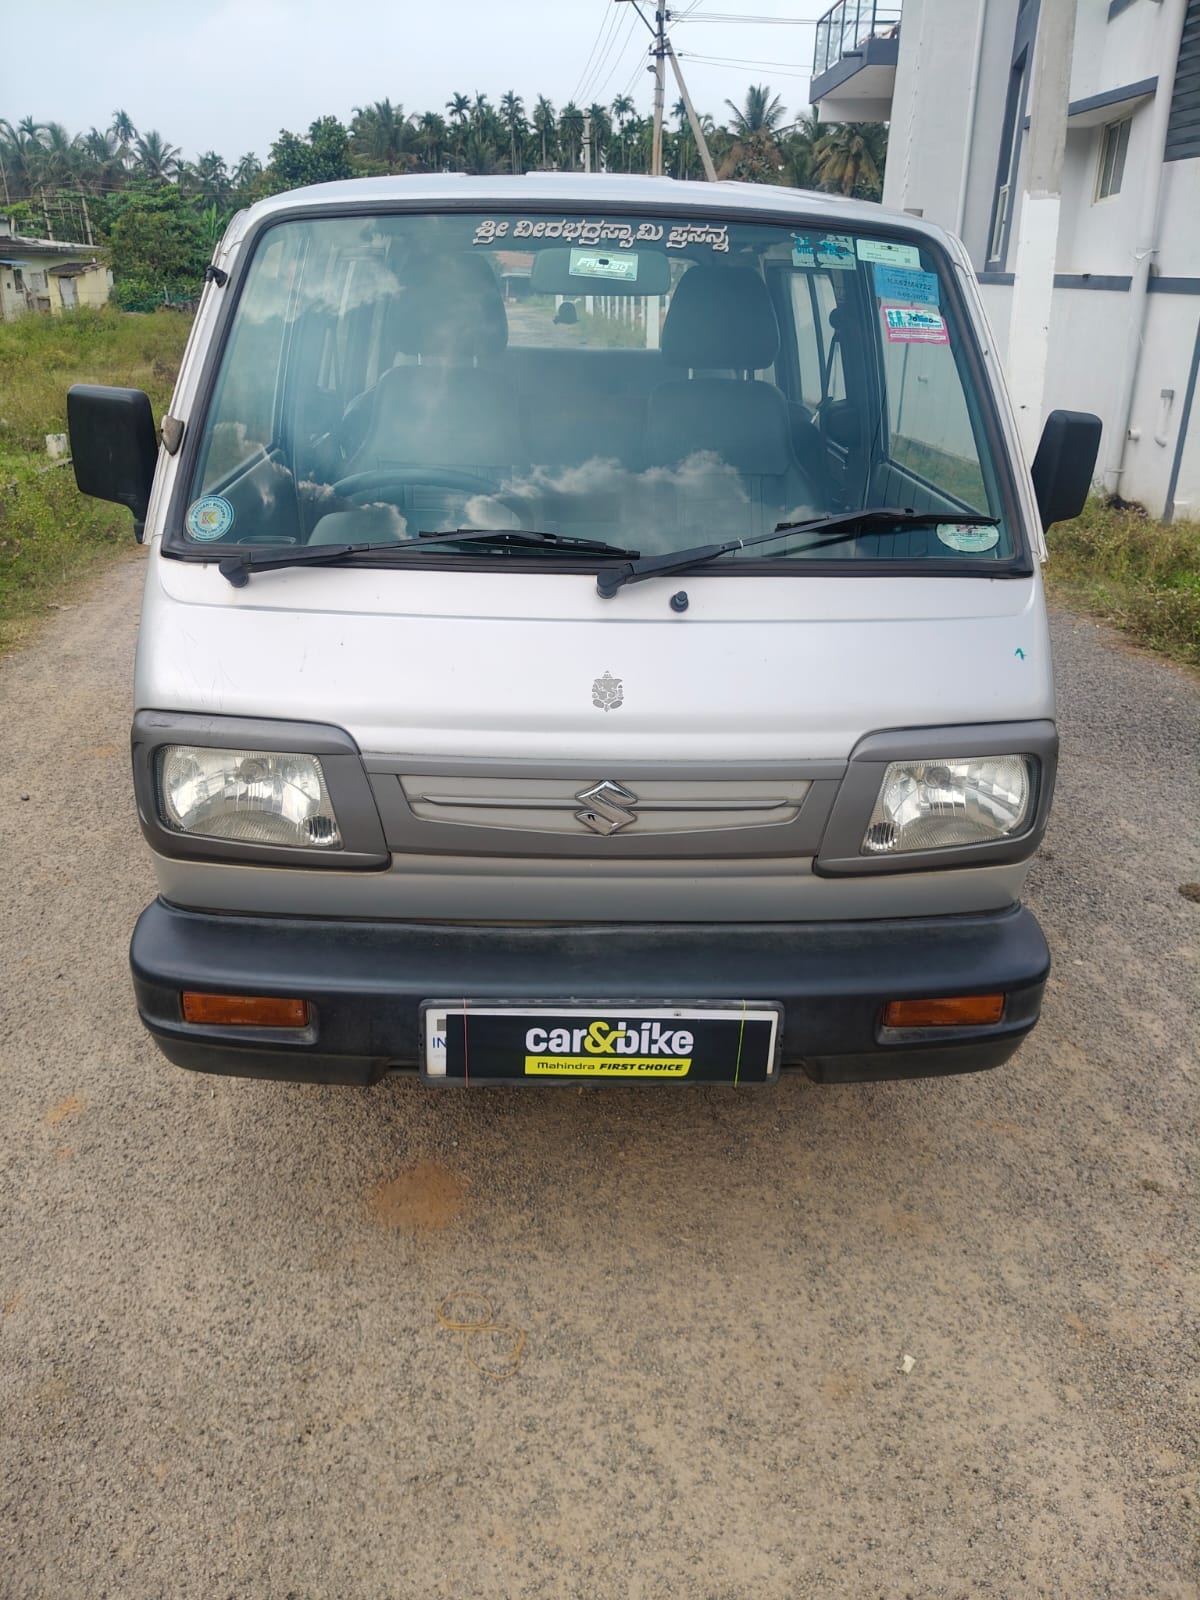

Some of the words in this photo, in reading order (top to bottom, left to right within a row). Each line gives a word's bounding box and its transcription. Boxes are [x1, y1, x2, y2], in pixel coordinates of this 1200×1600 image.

[473, 220, 509, 244] ಶ್ರೀ
[666, 223, 729, 252] ಪ್ರಸನ್ನ
[525, 1021, 694, 1055] car&bike
[536, 1061, 596, 1071] Mahindra
[599, 1063, 637, 1071] FIRST
[637, 1063, 684, 1072] CHOICE
